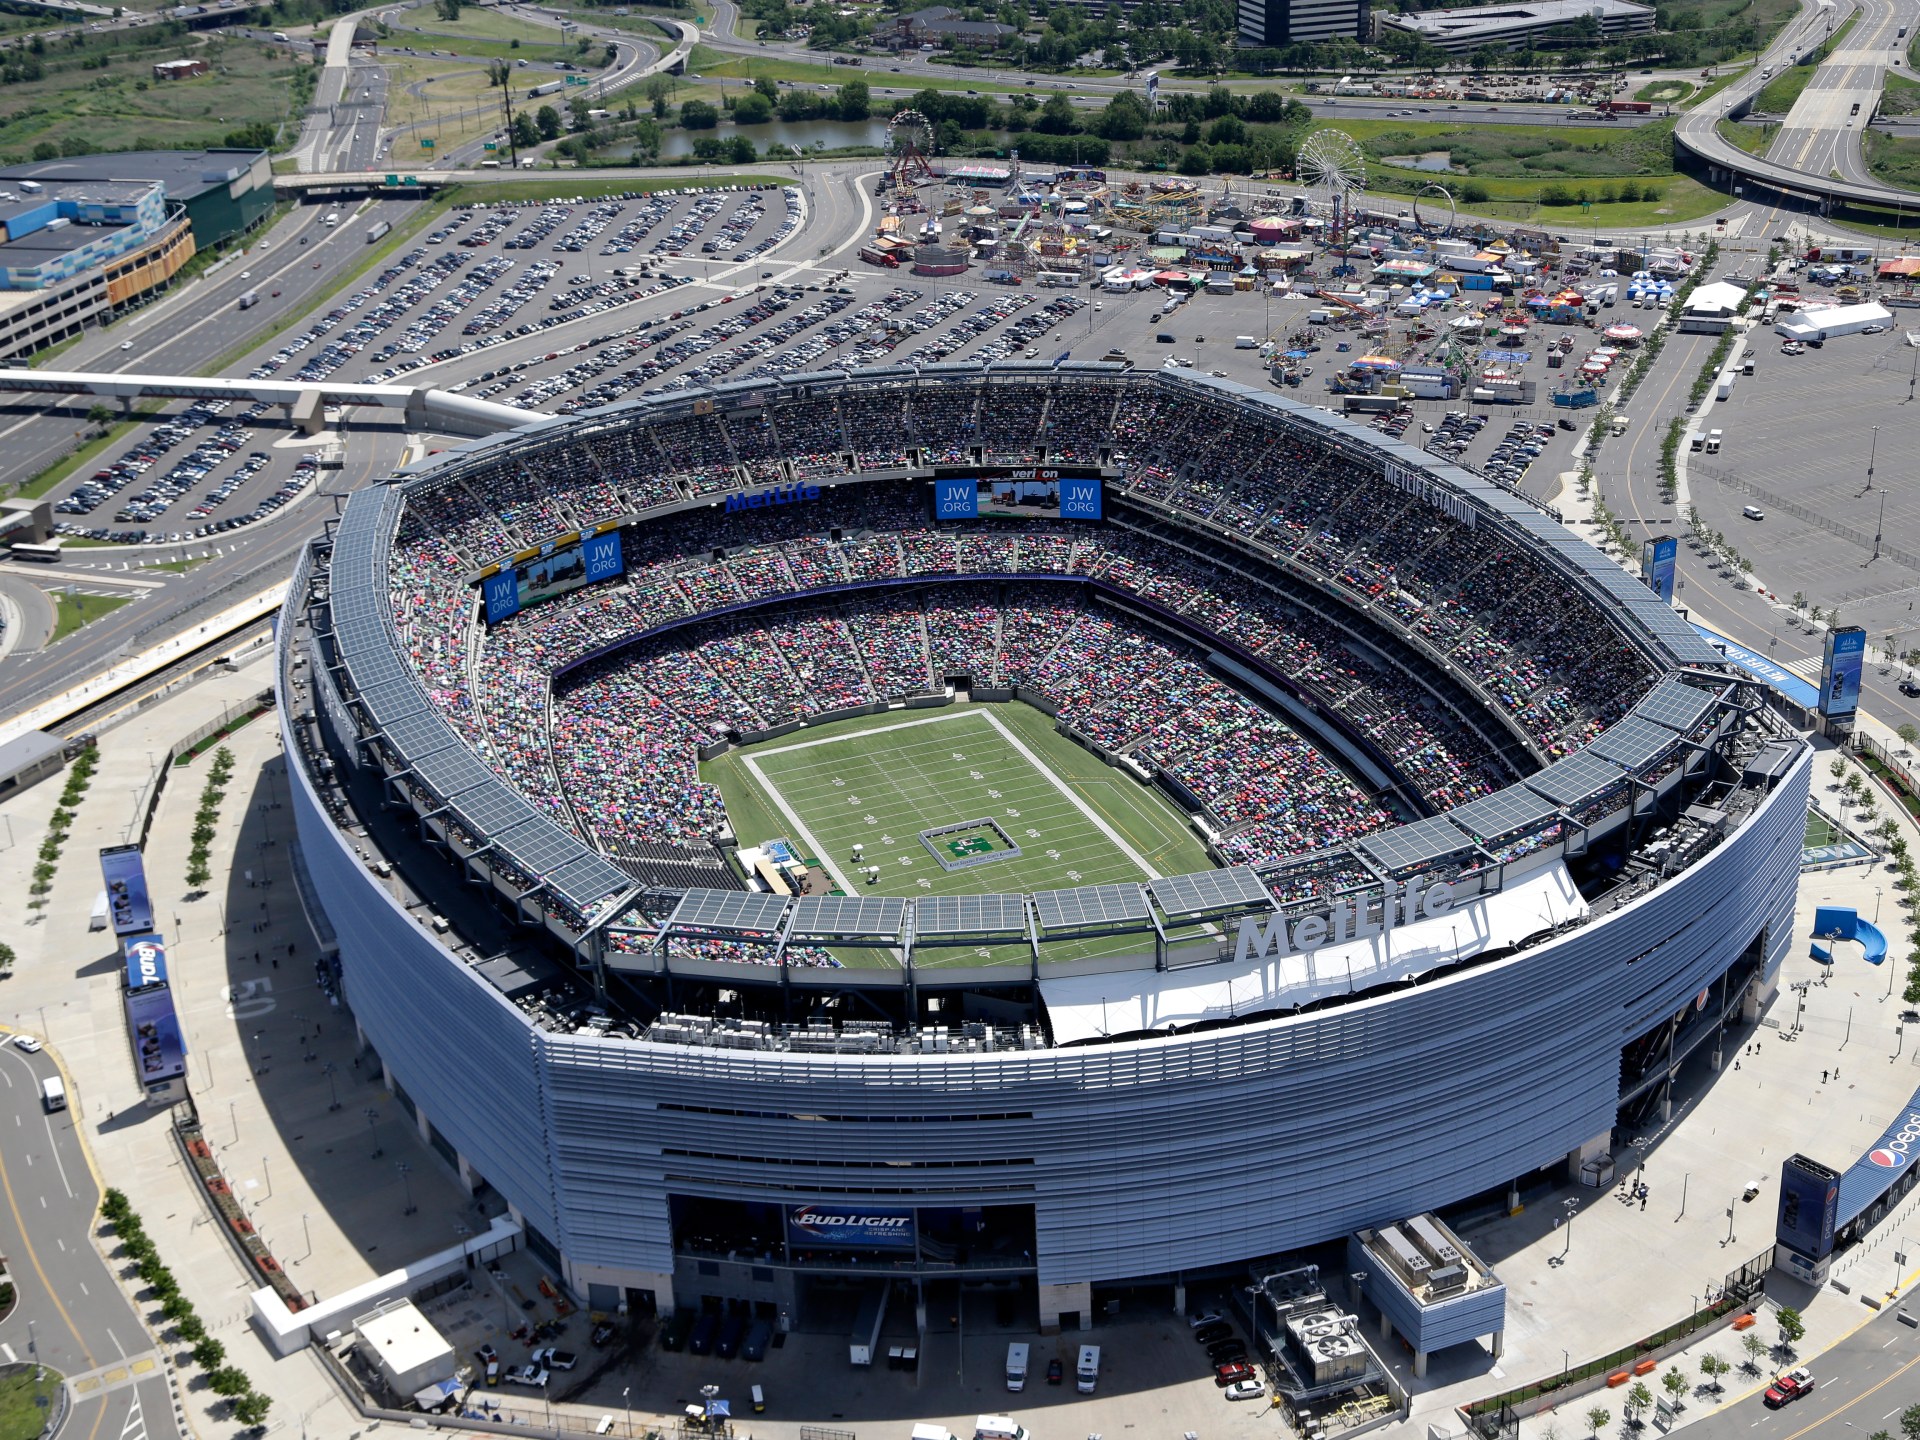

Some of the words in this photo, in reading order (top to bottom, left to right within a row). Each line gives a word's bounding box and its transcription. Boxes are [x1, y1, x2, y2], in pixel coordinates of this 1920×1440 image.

[1012, 468, 1058, 480] verizon
[725, 481, 820, 514] MetLife
[944, 486, 970, 501] JW
[1068, 487, 1094, 501] JW
[1384, 462, 1428, 502] METLIFE
[1432, 488, 1476, 530] STADIUM
[942, 502, 970, 512] .ORG
[1066, 502, 1094, 512] .ORG
[591, 542, 614, 562] JW
[590, 558, 616, 574] .ORG
[492, 580, 511, 602] JW
[492, 596, 514, 614] .ORG
[1742, 657, 1790, 682] METLIFE
[1234, 874, 1454, 964] MetLife
[800, 1214, 846, 1226] BUD
[846, 1215, 910, 1227] LIGHT
[1824, 1206, 1833, 1240] pepsi
